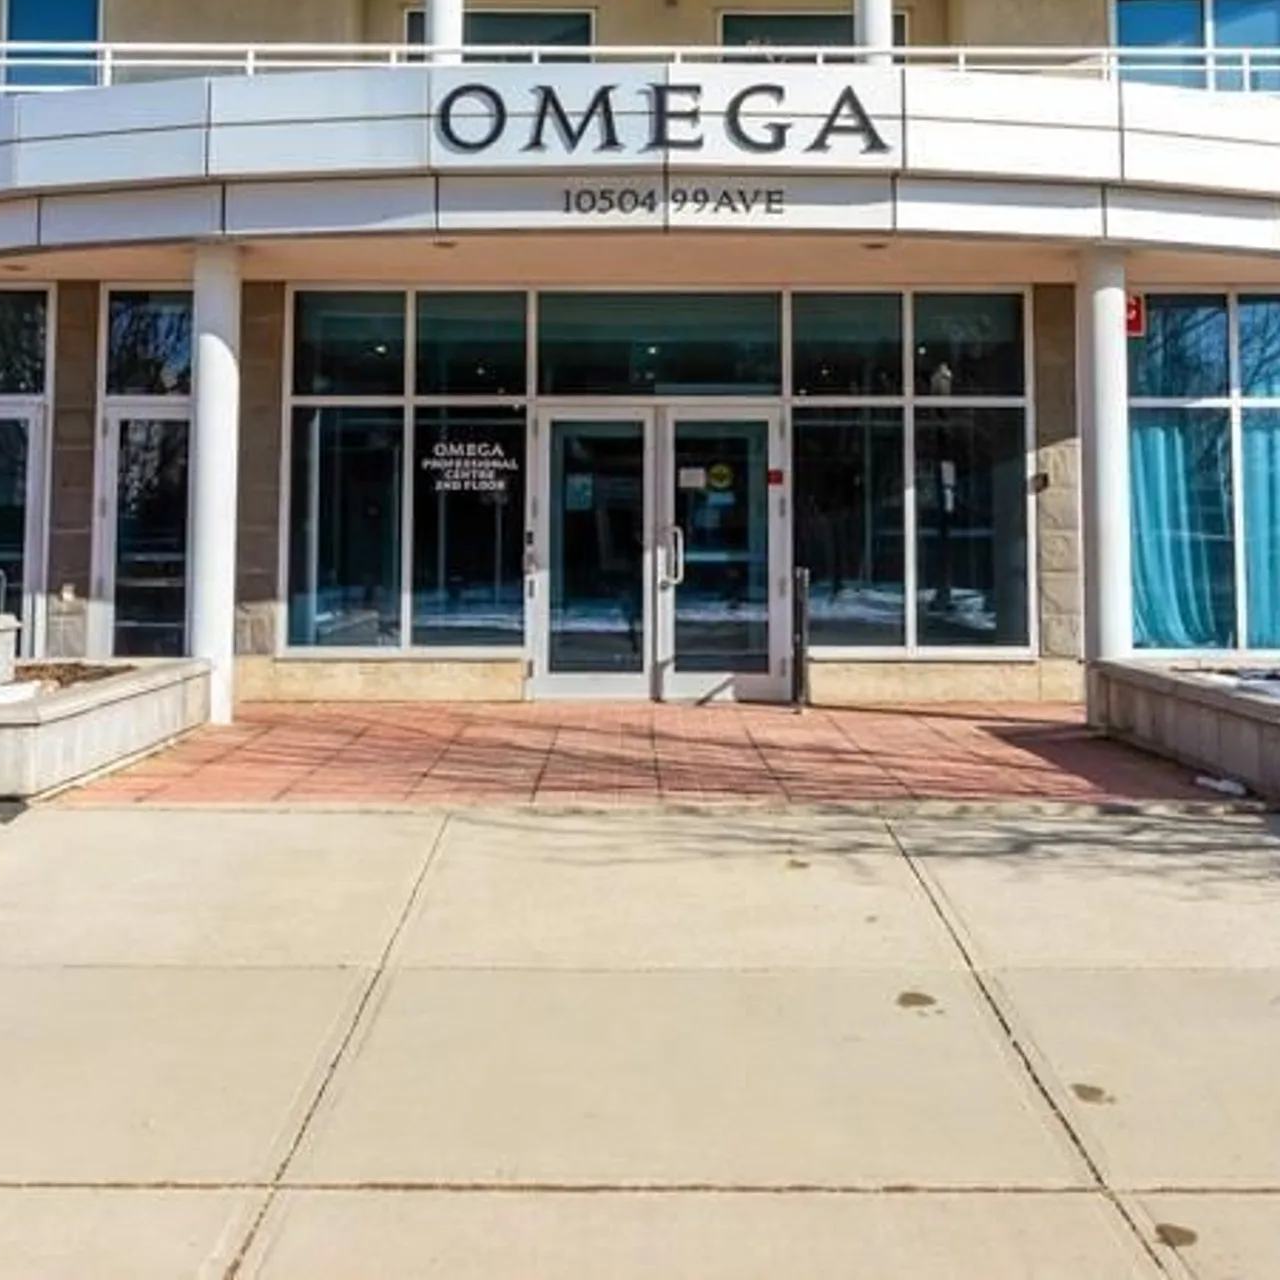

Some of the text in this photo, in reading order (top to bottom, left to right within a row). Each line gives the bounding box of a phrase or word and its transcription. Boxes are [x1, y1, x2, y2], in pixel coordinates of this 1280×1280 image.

[435, 82, 890, 154] OMEGA
[562, 188, 657, 214] 10504
[433, 442, 505, 456] OMEGA
